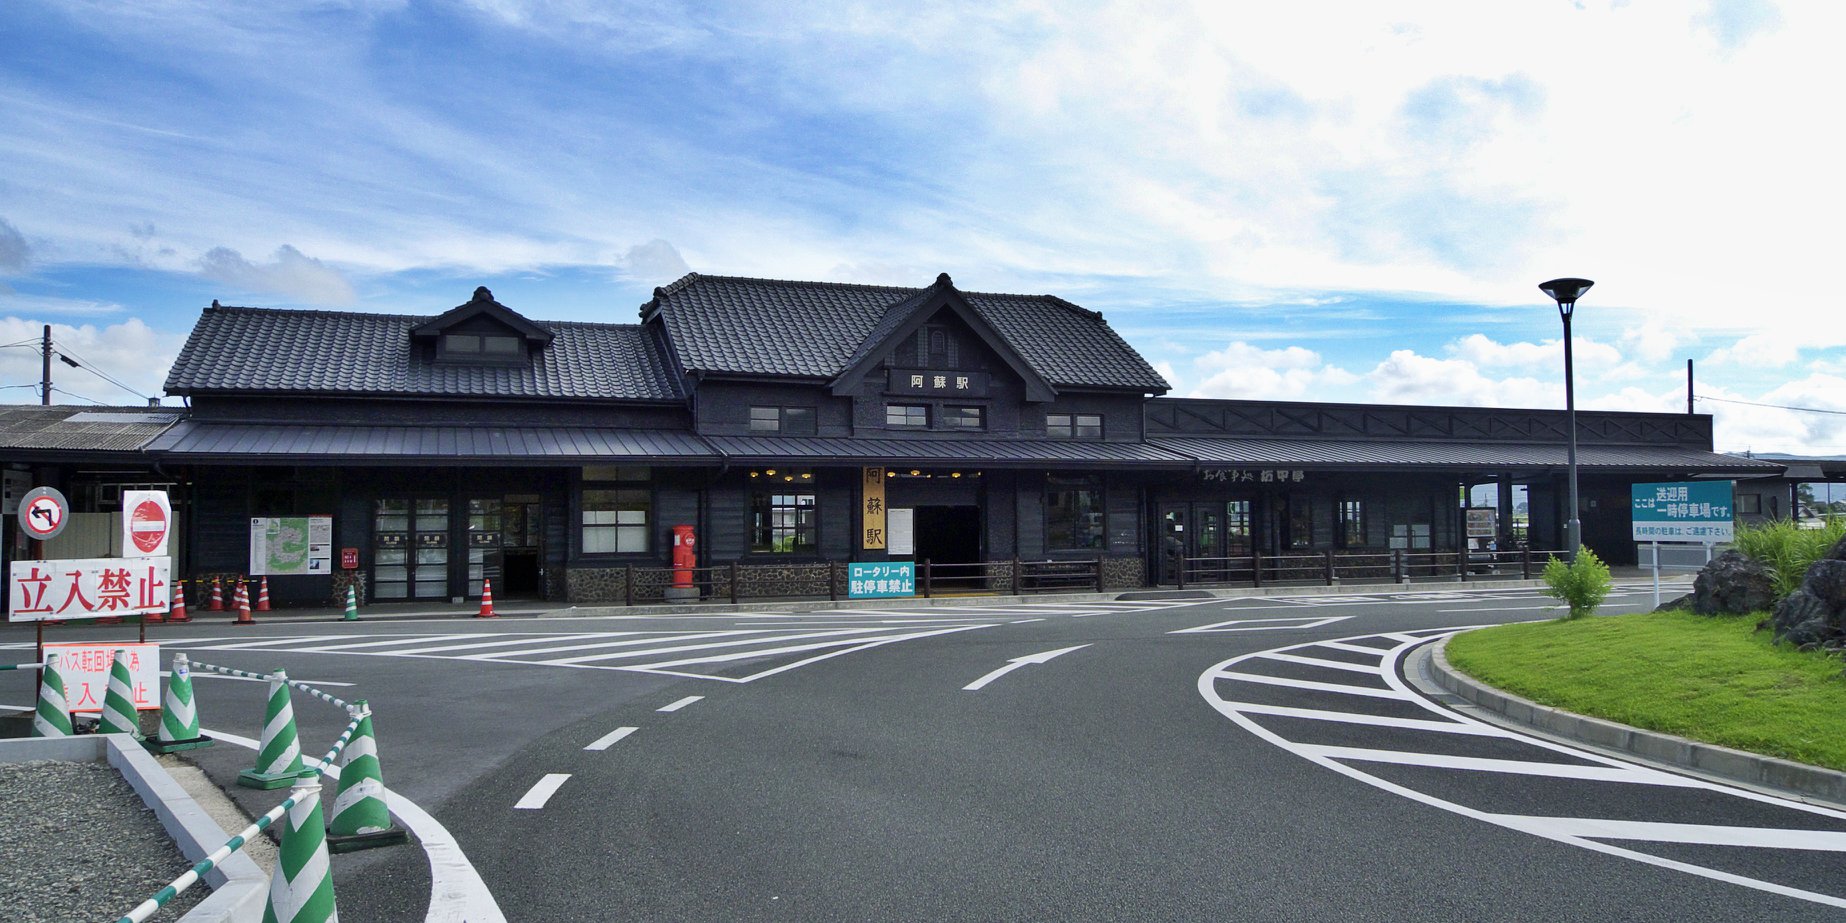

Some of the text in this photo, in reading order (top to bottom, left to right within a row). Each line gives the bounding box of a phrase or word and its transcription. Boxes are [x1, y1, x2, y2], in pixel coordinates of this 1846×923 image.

[911, 374, 969, 390] 阿蘇駅
[1656, 487, 1688, 502] 送迎用
[865, 467, 883, 545] 阿蘇駅
[1634, 498, 1655, 508] ここは
[1657, 502, 1731, 518] 一時停車場です。
[854, 566, 910, 577] ロータリー内
[14, 566, 166, 614] 立入禁止
[851, 579, 913, 594] 駐停車禁止
[59, 650, 140, 673] バス転回場為
[64, 681, 149, 707] 入止
